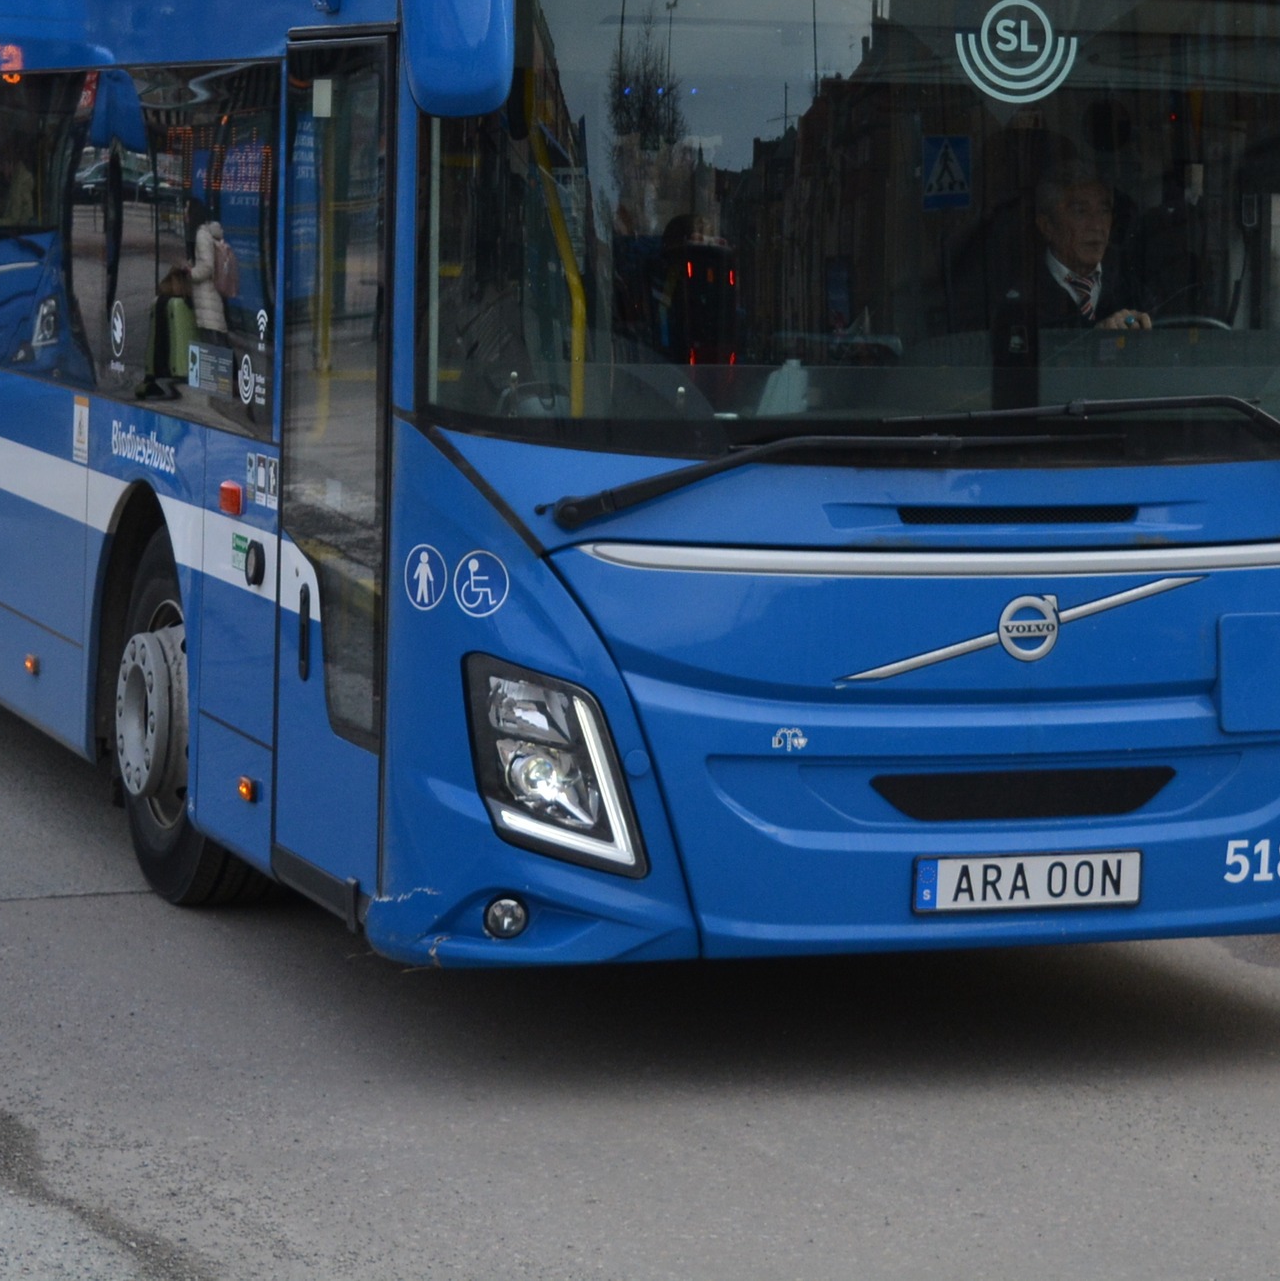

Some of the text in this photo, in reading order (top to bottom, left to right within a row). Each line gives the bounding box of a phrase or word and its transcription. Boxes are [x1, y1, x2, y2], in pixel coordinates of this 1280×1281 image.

[995, 18, 1039, 52] SL
[111, 419, 176, 475] Biodieselbuss
[1003, 623, 1056, 634] VOLVO
[922, 888, 932, 901] S
[952, 862, 1031, 903] ARA
